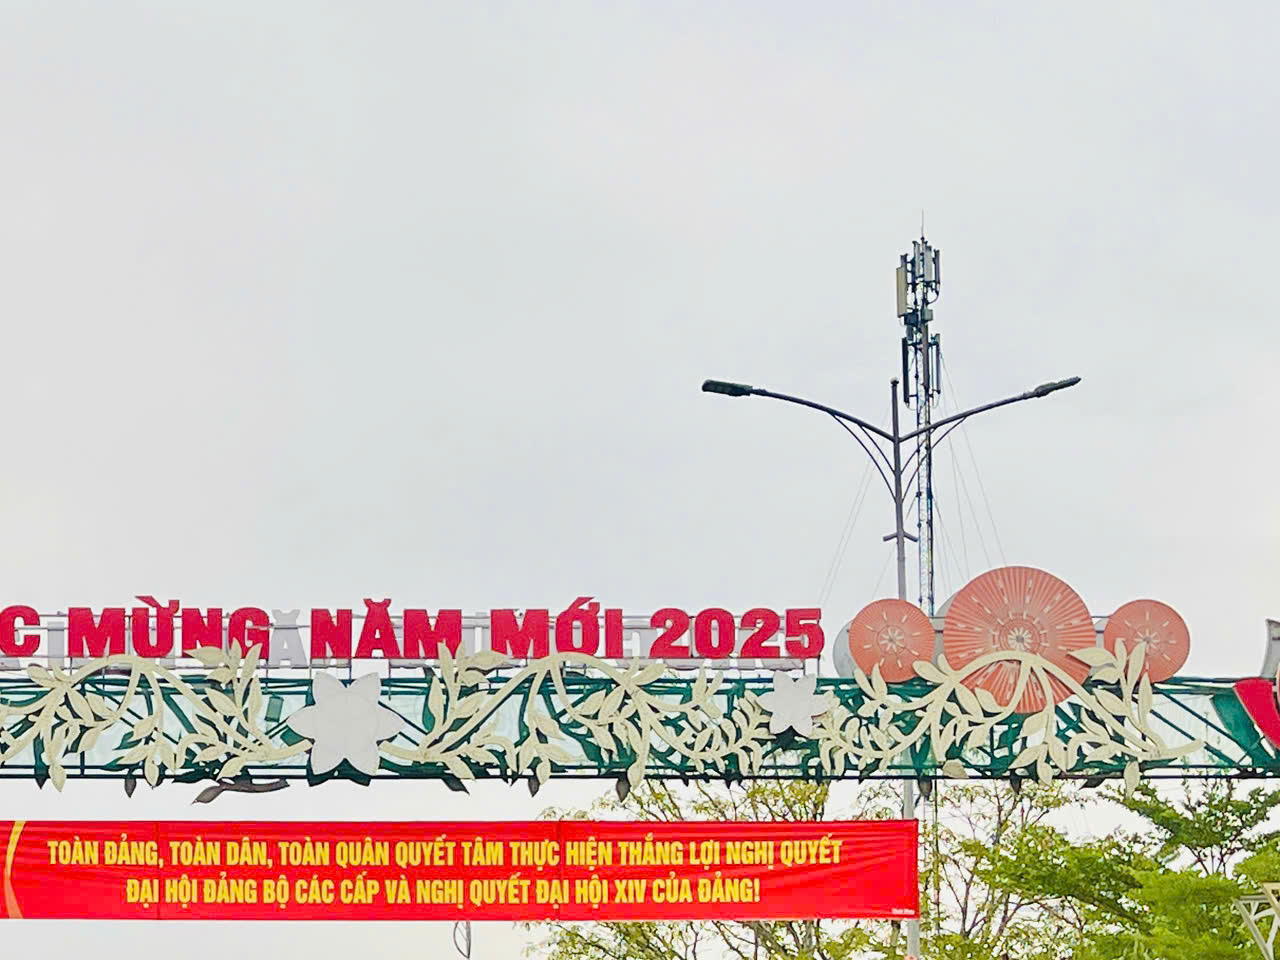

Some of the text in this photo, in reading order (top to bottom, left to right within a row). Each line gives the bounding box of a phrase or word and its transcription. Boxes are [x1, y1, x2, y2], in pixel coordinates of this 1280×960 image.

[68, 595, 270, 659] MỪNG
[311, 598, 463, 660] NĂM
[490, 597, 624, 660] MỚI
[650, 607, 825, 660] 2025
[48, 832, 844, 870] TOÀN ĐẢNG, TOÀN DÂN, TOÀN QUÂN QUYẾT TÂM THỰC HIỆN THẮNG LỢI NGHỊ QUYẾT
[126, 871, 761, 909] ĐẠI HỘI ĐẢNG BỘ CÁC CẤP VÀ NGHỊ QUYẾT ĐẠI HỘI XIV CỦA ĐẢNG!
